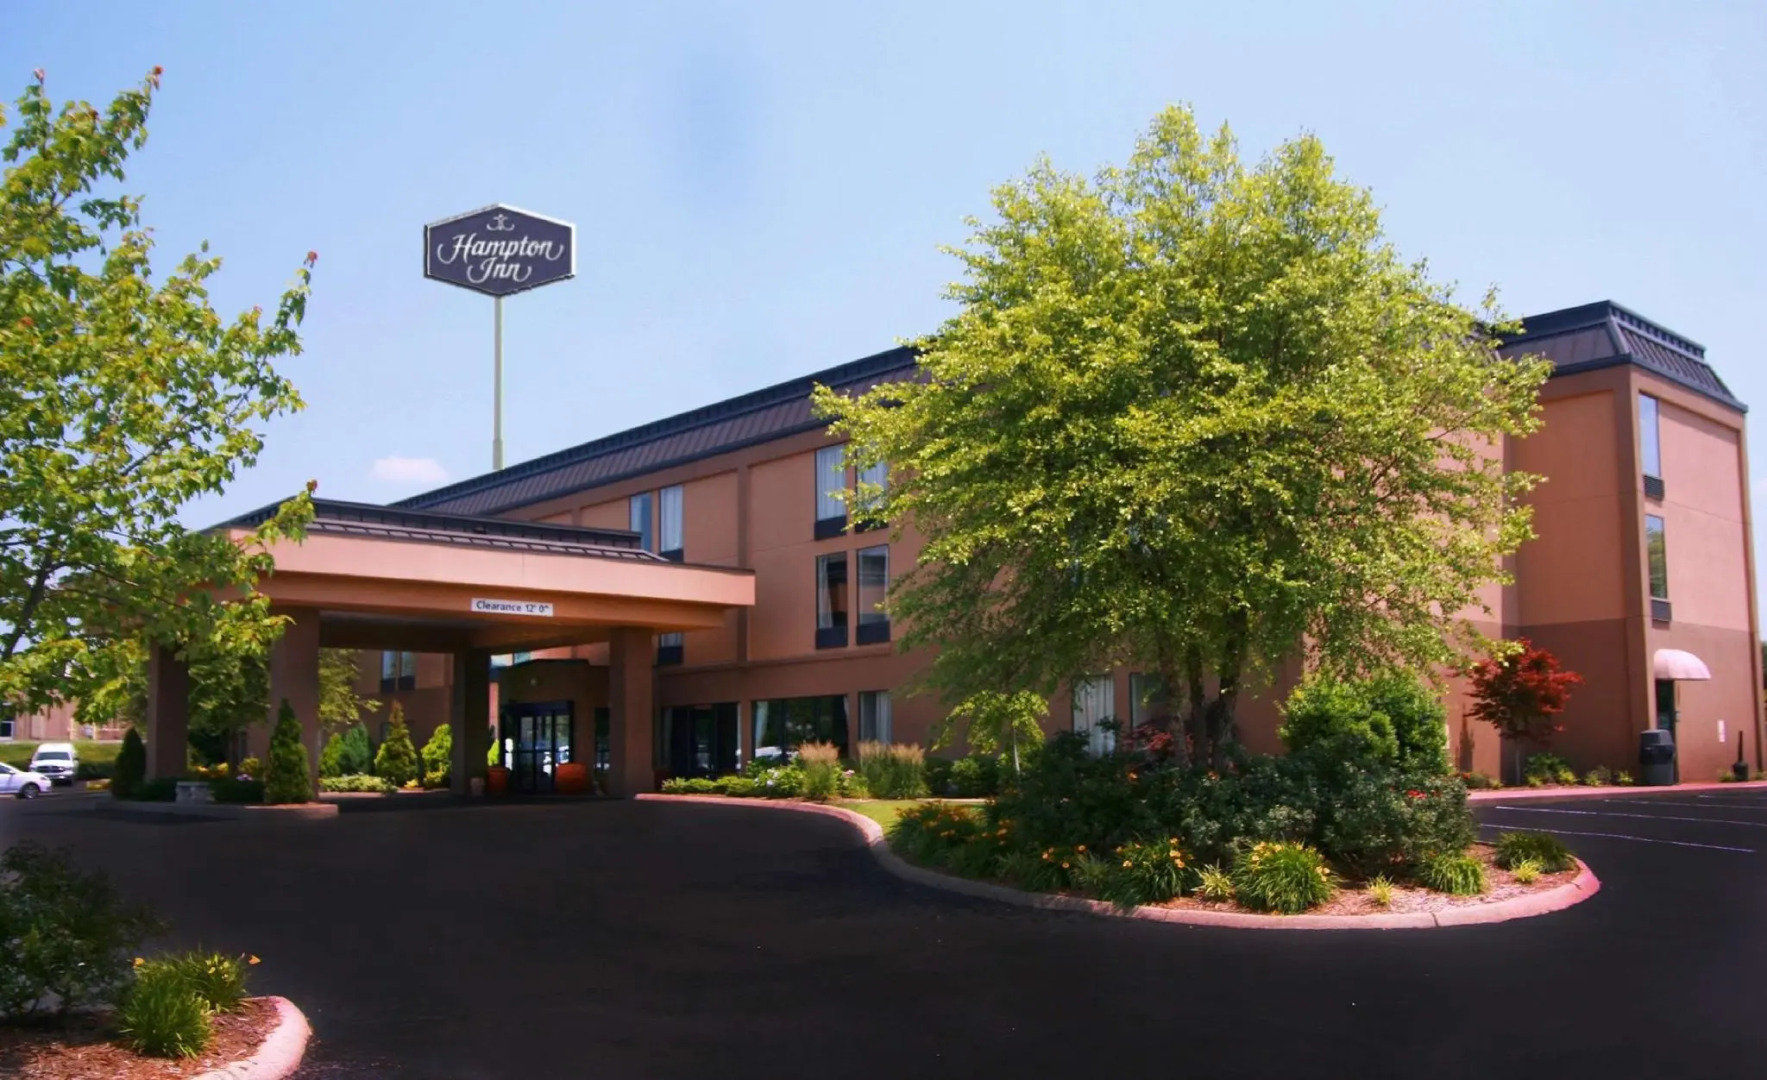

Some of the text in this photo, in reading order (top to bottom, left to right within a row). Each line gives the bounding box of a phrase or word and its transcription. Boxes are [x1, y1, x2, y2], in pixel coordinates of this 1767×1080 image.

[437, 233, 564, 264] Hampton
[467, 257, 532, 283] Inn
[476, 600, 522, 612] Clearance
